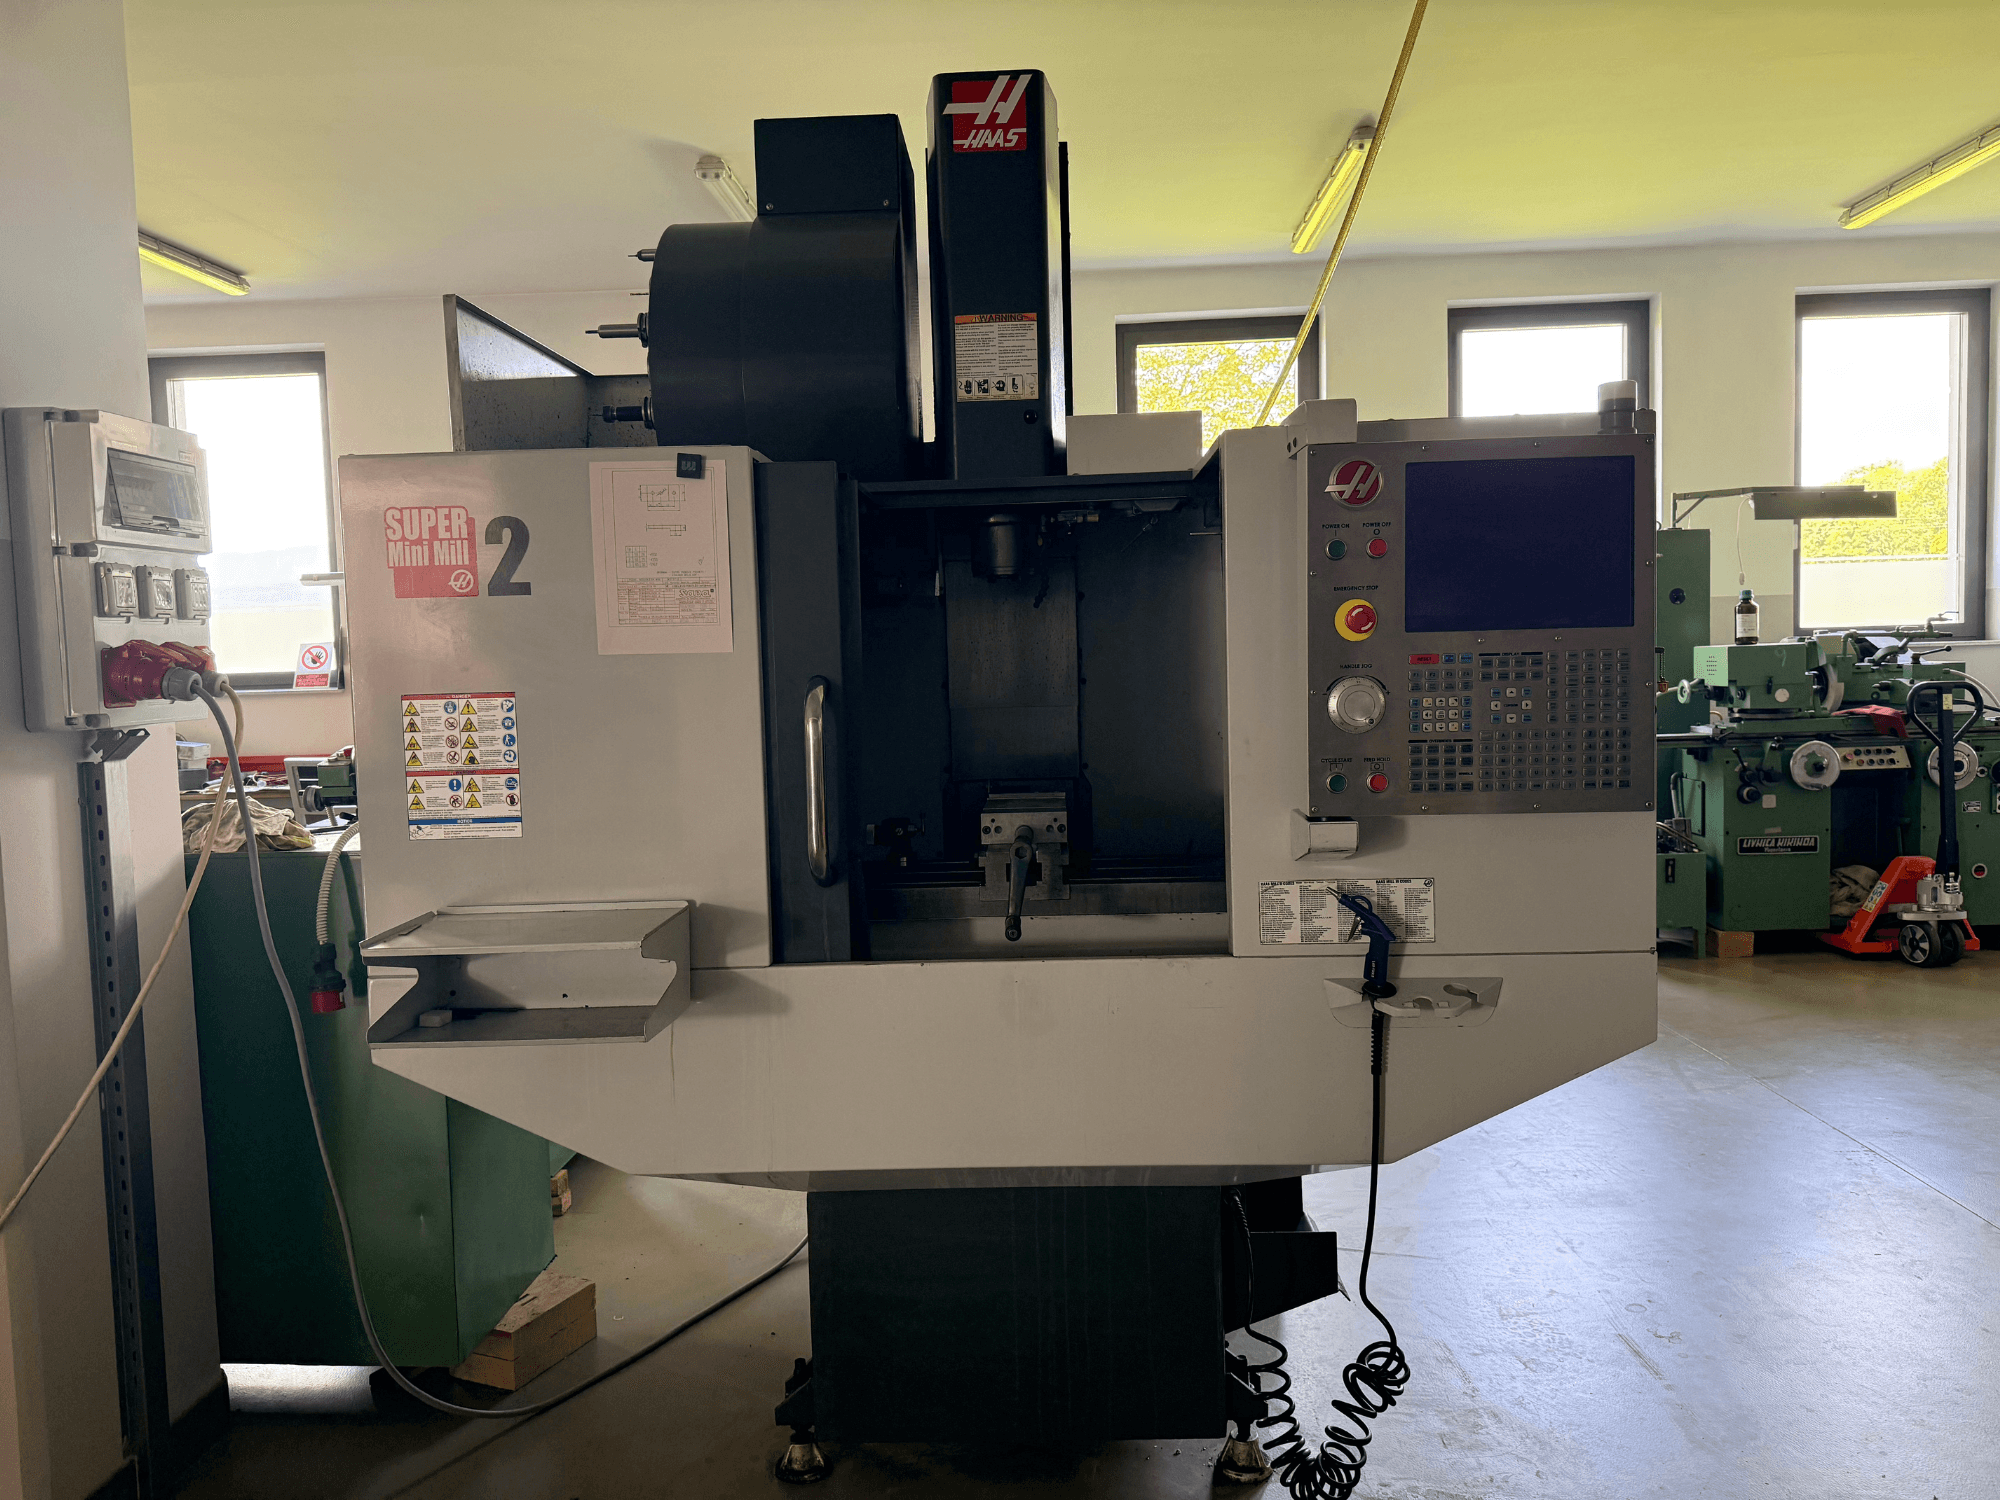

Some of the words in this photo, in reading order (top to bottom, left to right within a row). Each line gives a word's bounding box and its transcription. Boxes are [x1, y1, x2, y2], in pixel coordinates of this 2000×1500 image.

[953, 128, 1027, 148] HAAS
[979, 313, 1024, 322] WARNING
[385, 507, 468, 540] SUPER
[388, 541, 430, 567] Mini
[433, 540, 470, 566] Mill
[485, 515, 531, 597] 2
